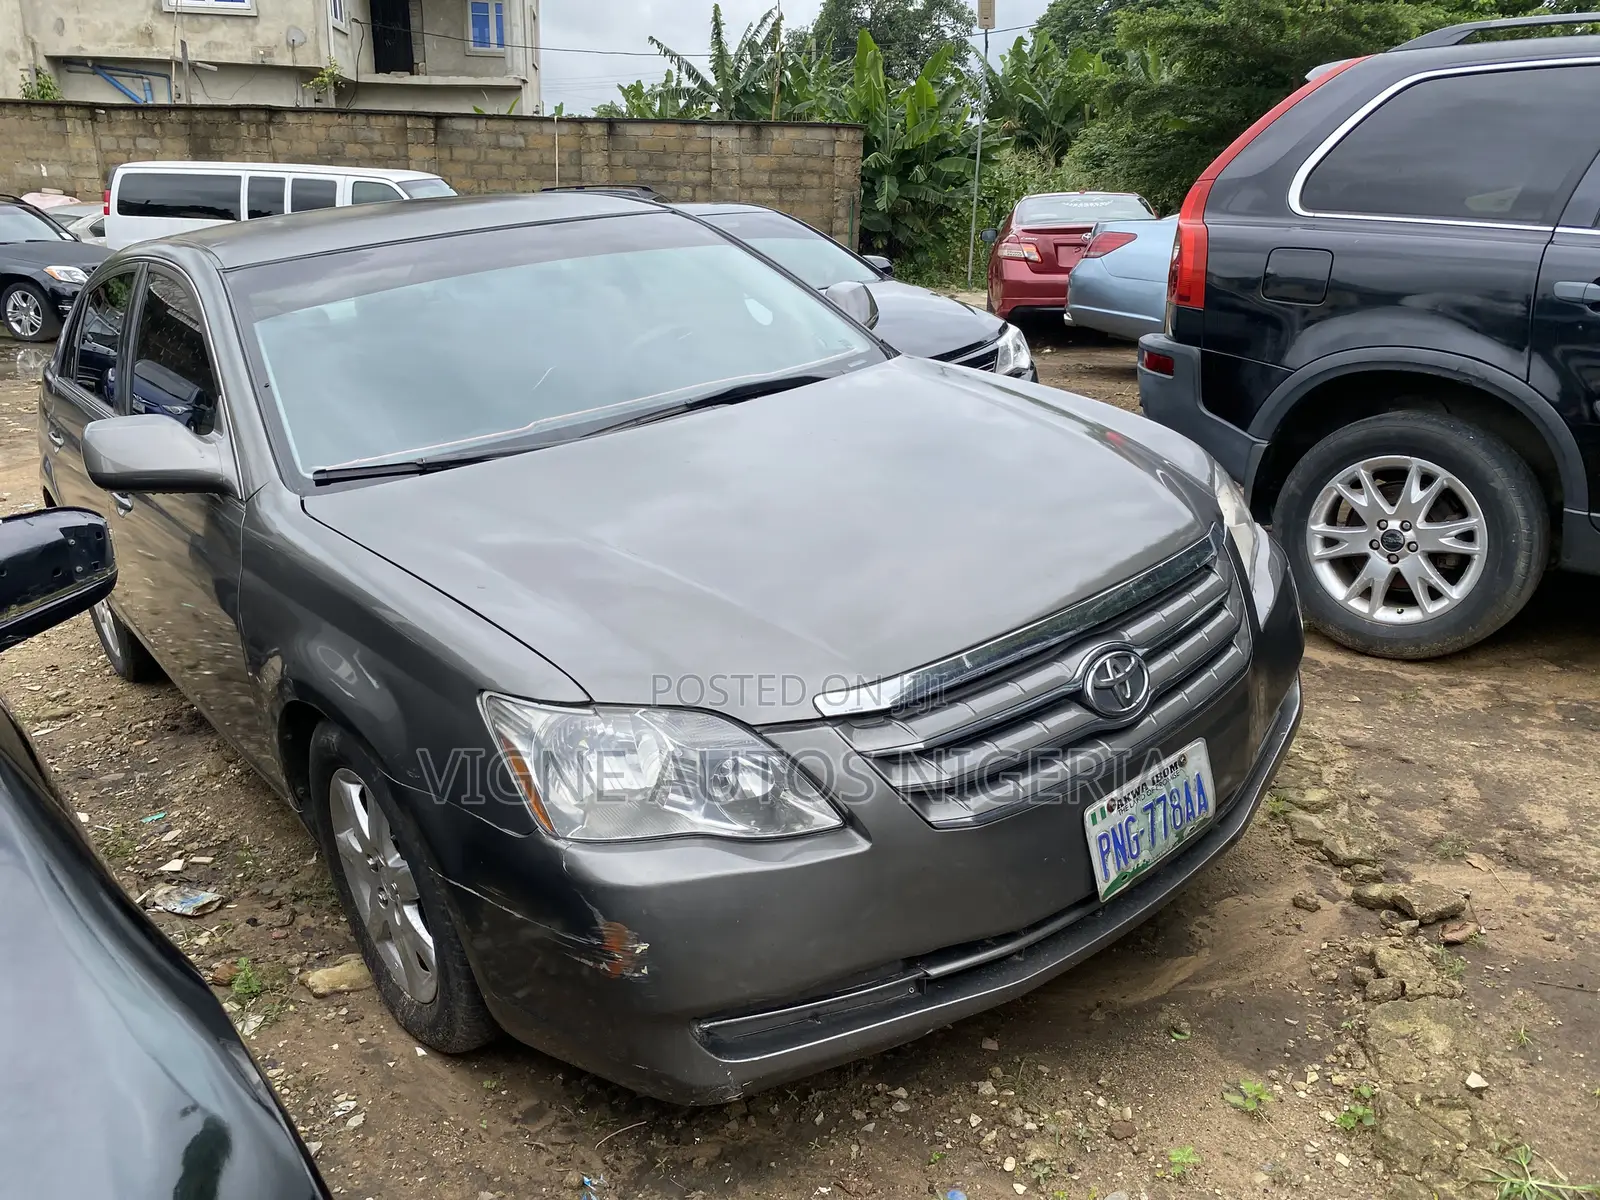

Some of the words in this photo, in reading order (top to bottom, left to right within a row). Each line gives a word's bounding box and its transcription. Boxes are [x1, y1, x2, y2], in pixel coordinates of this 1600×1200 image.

[1117, 782, 1149, 810] AKWA
[1151, 761, 1179, 786] IBOM
[1118, 805, 1129, 816] THE
[1130, 793, 1146, 809] LAND
[1097, 772, 1208, 881] PNG-778AA
